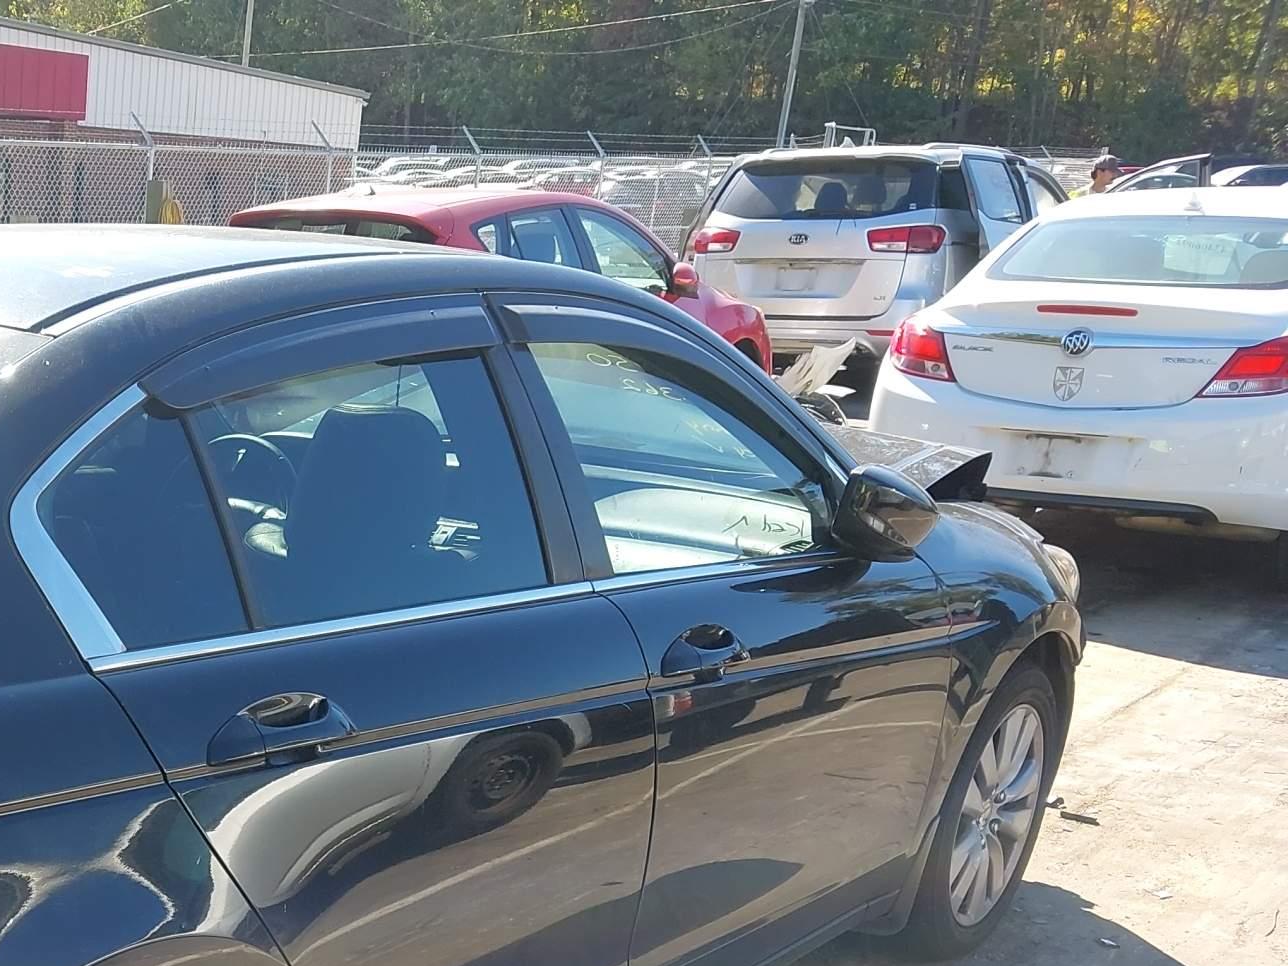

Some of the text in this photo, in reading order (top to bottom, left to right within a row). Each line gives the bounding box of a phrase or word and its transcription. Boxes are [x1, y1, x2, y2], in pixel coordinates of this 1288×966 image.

[789, 234, 809, 244] KIA
[952, 344, 994, 352] BUICK
[1161, 356, 1217, 365] REGAL
